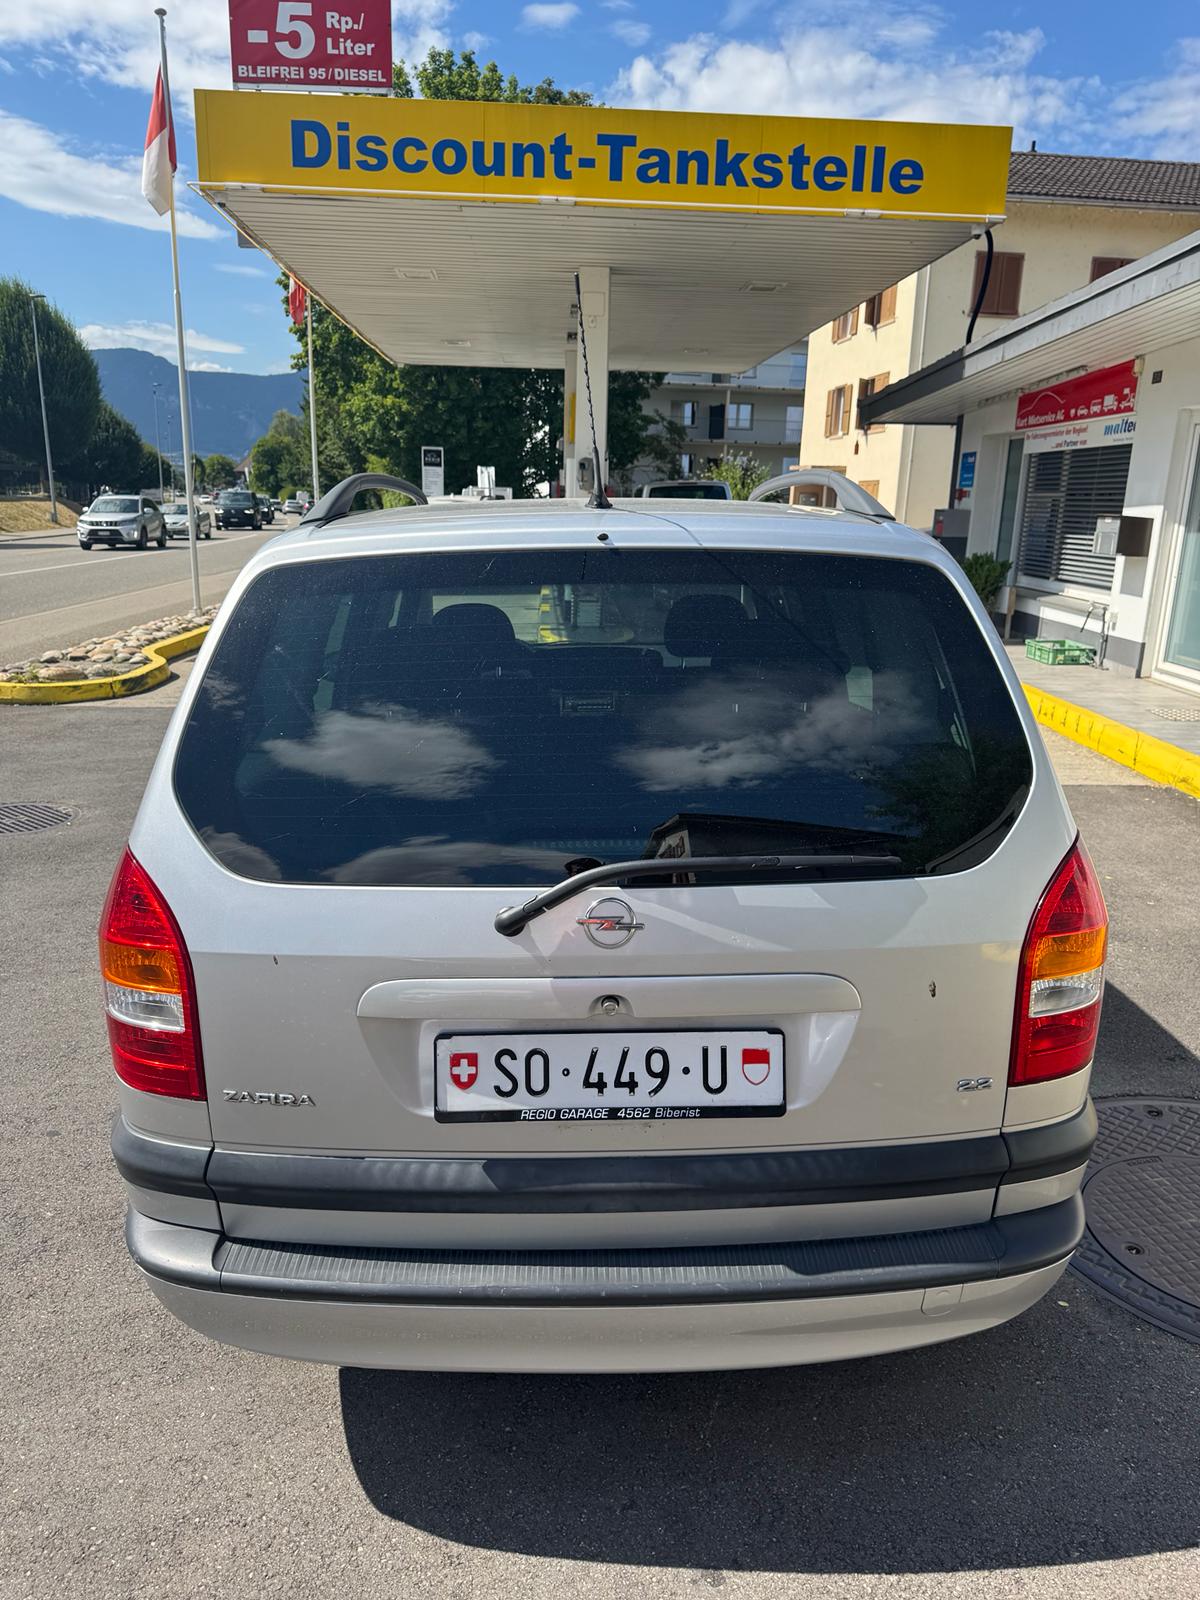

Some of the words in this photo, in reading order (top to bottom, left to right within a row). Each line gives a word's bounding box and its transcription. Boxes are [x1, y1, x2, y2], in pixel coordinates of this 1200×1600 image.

[247, 1, 316, 60] -5
[325, 11, 365, 33] Rp./
[326, 37, 376, 57] Liter
[237, 65, 304, 80] BLEIFREI
[290, 119, 925, 195] Discount-Tankstelle
[222, 1089, 316, 1107] ZAFIRA
[520, 1108, 557, 1120] REGIO
[560, 1108, 610, 1119] GARAGE
[617, 1107, 651, 1118] 4562
[654, 1107, 701, 1118] Biberist
